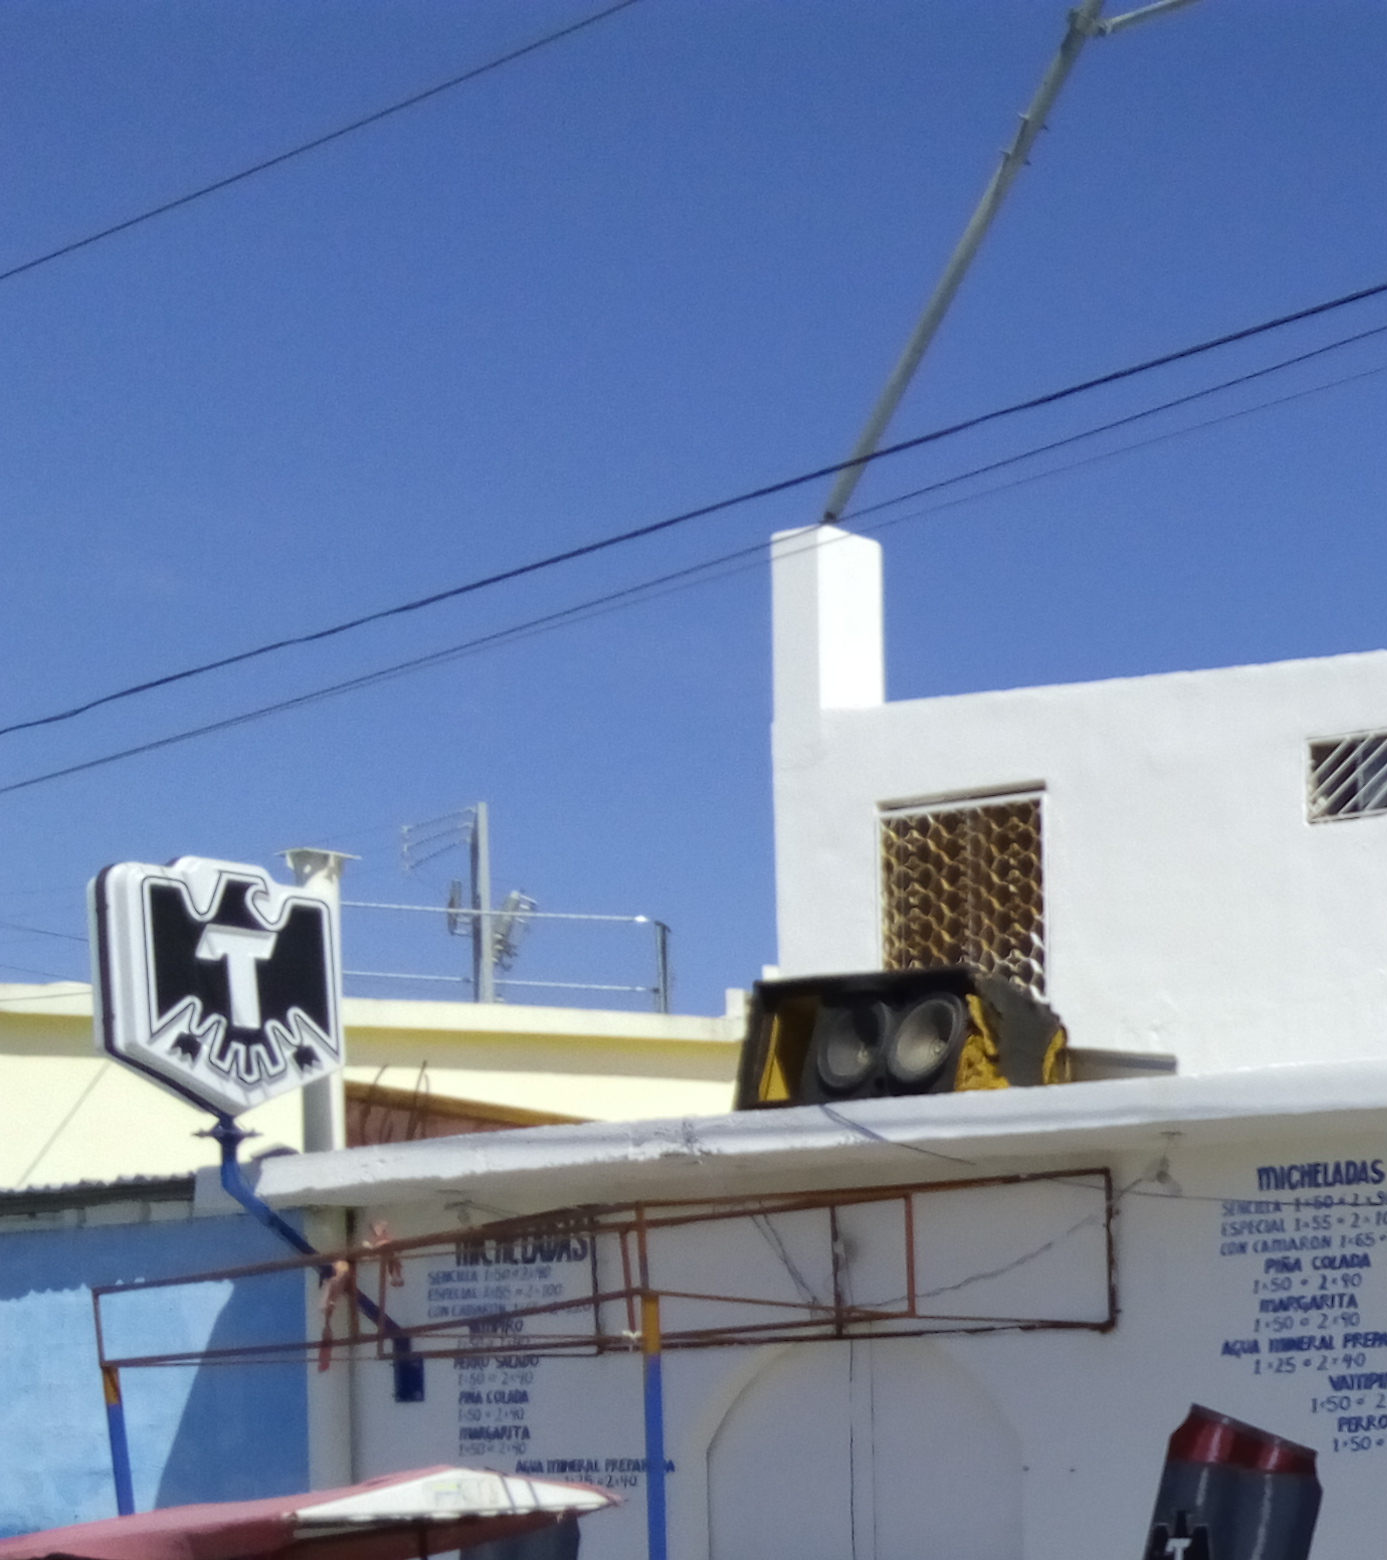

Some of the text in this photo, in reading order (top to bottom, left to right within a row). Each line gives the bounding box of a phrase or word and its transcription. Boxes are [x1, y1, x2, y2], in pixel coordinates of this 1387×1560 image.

[1256, 1159, 1386, 1191] MICHELADAS
[1221, 1218, 1286, 1236] ESPECIAL
[1312, 1252, 1371, 1271] COLADA
[1259, 1293, 1358, 1314] MARGARITA
[1220, 1339, 1261, 1358] AGUA
